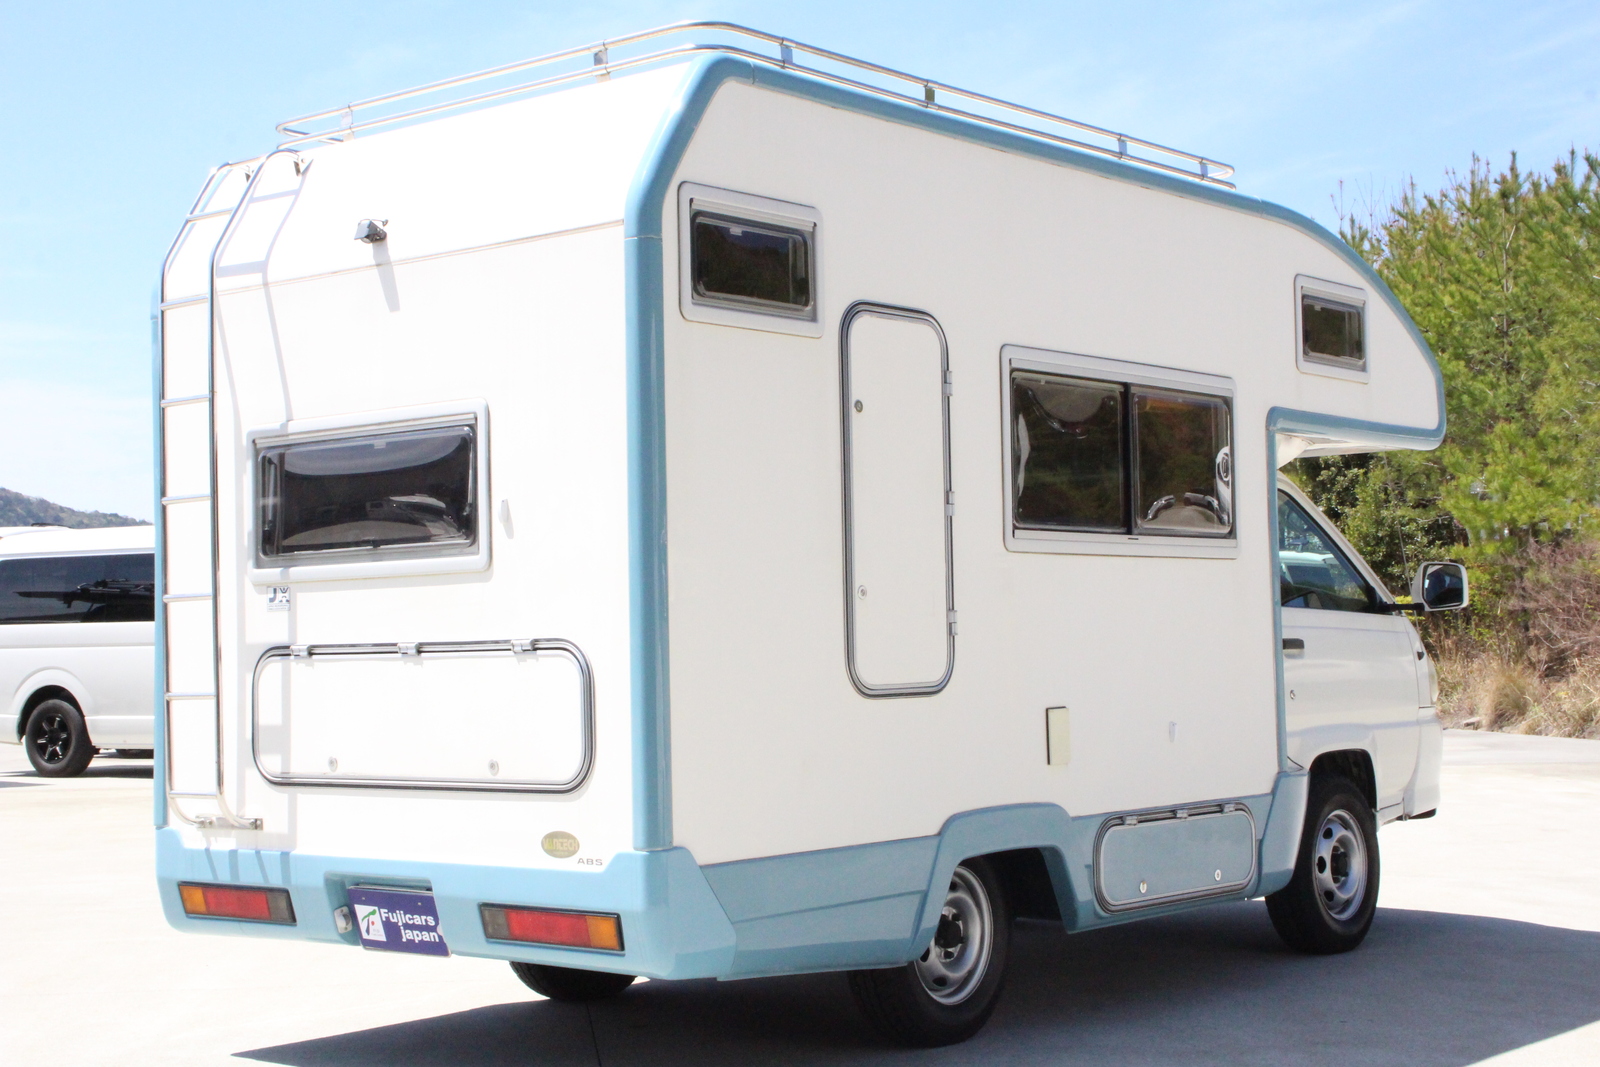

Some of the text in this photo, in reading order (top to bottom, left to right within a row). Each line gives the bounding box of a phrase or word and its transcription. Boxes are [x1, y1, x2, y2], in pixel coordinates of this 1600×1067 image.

[577, 857, 603, 866] ABS
[380, 908, 436, 926] Fujicars
[400, 926, 440, 943] japan
